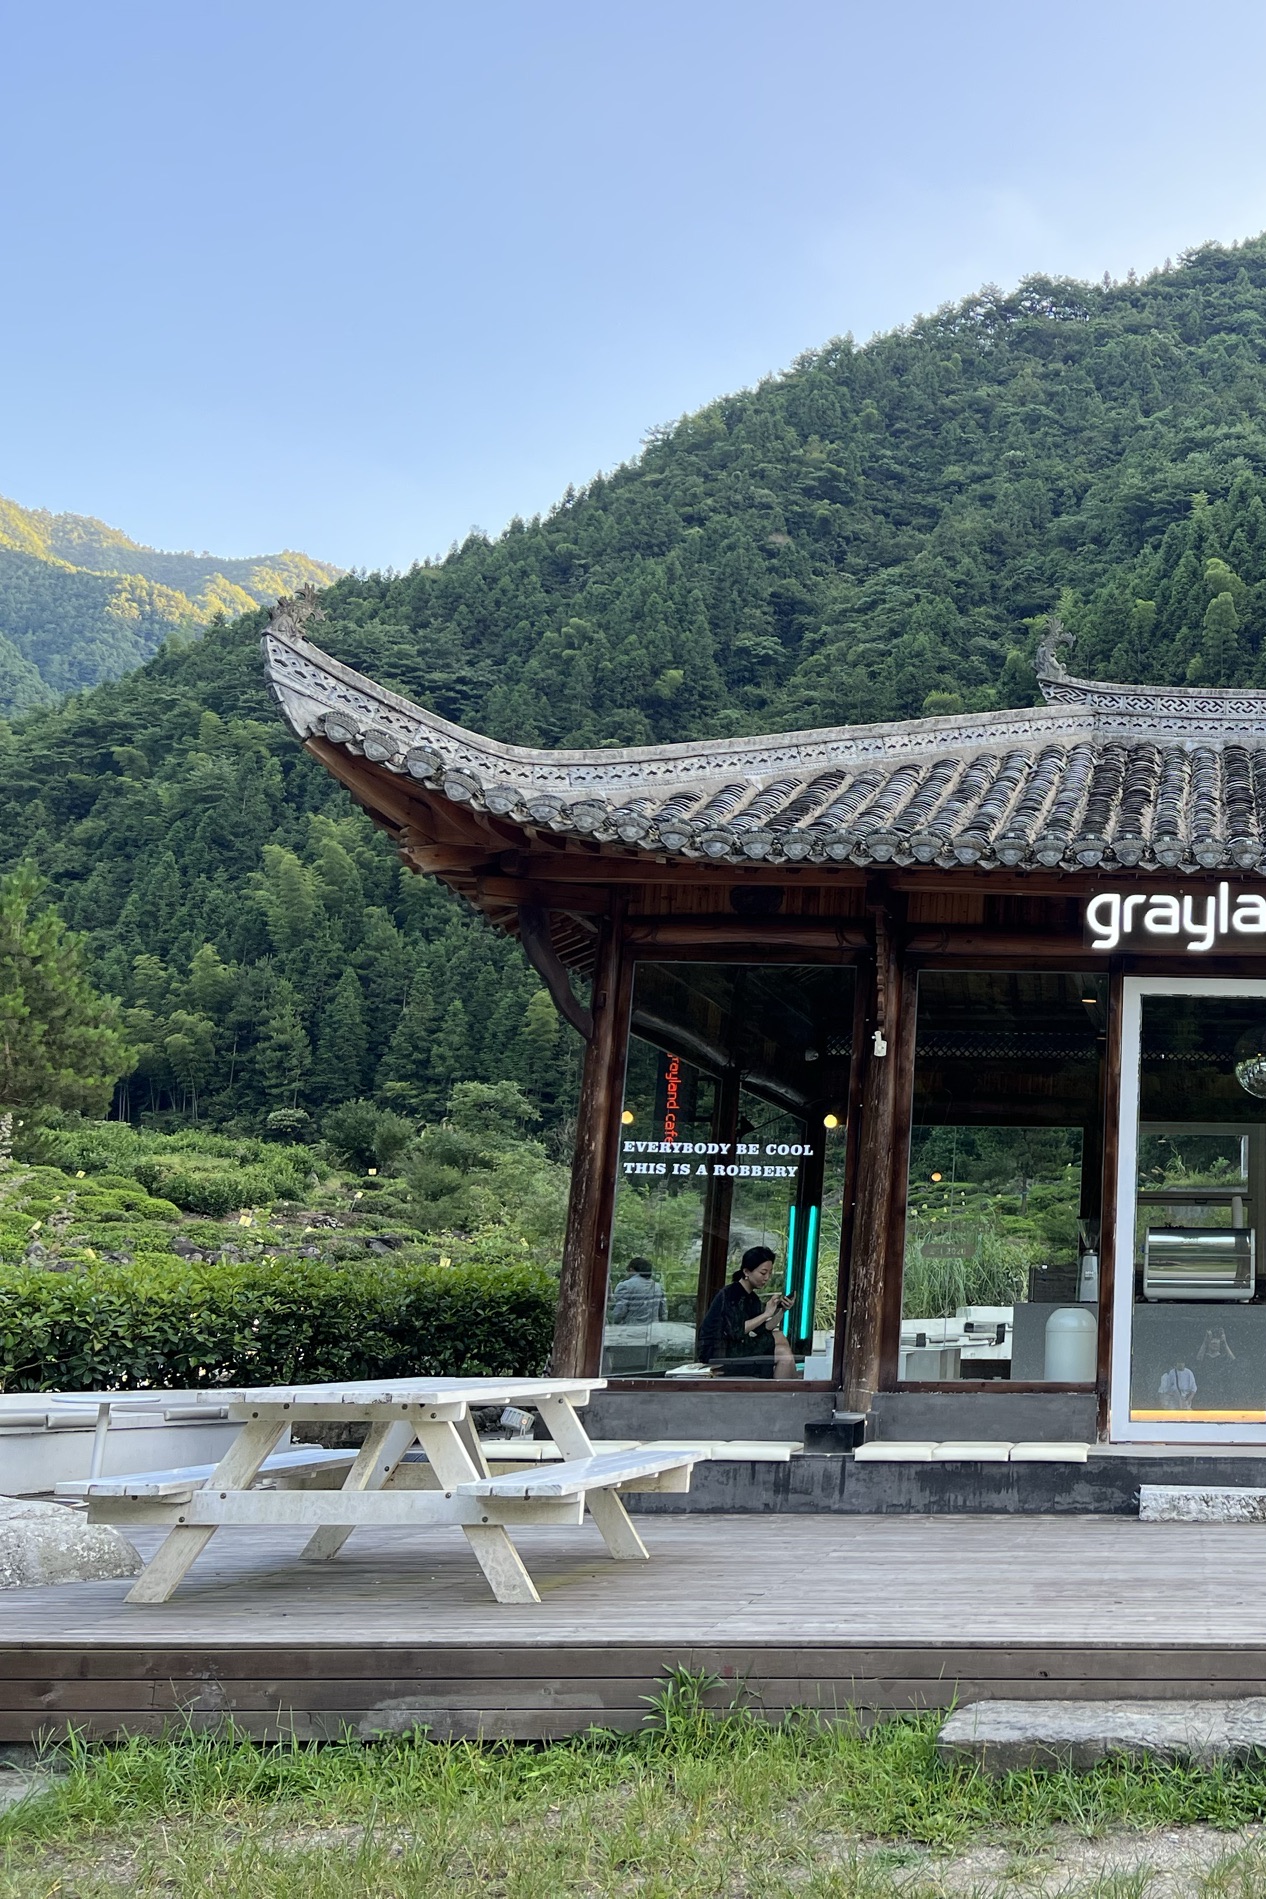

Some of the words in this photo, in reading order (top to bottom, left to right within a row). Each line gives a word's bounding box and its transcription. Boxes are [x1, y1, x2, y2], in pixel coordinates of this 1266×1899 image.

[664, 1113, 678, 1144] cafe
[623, 1140, 731, 1155] EVERYBODY
[736, 1143, 759, 1155] BE
[766, 1144, 814, 1156] COOL
[623, 1162, 666, 1175] THIS
[672, 1163, 691, 1175] IS
[696, 1164, 708, 1176] A
[713, 1165, 798, 1177] ROBBERY
